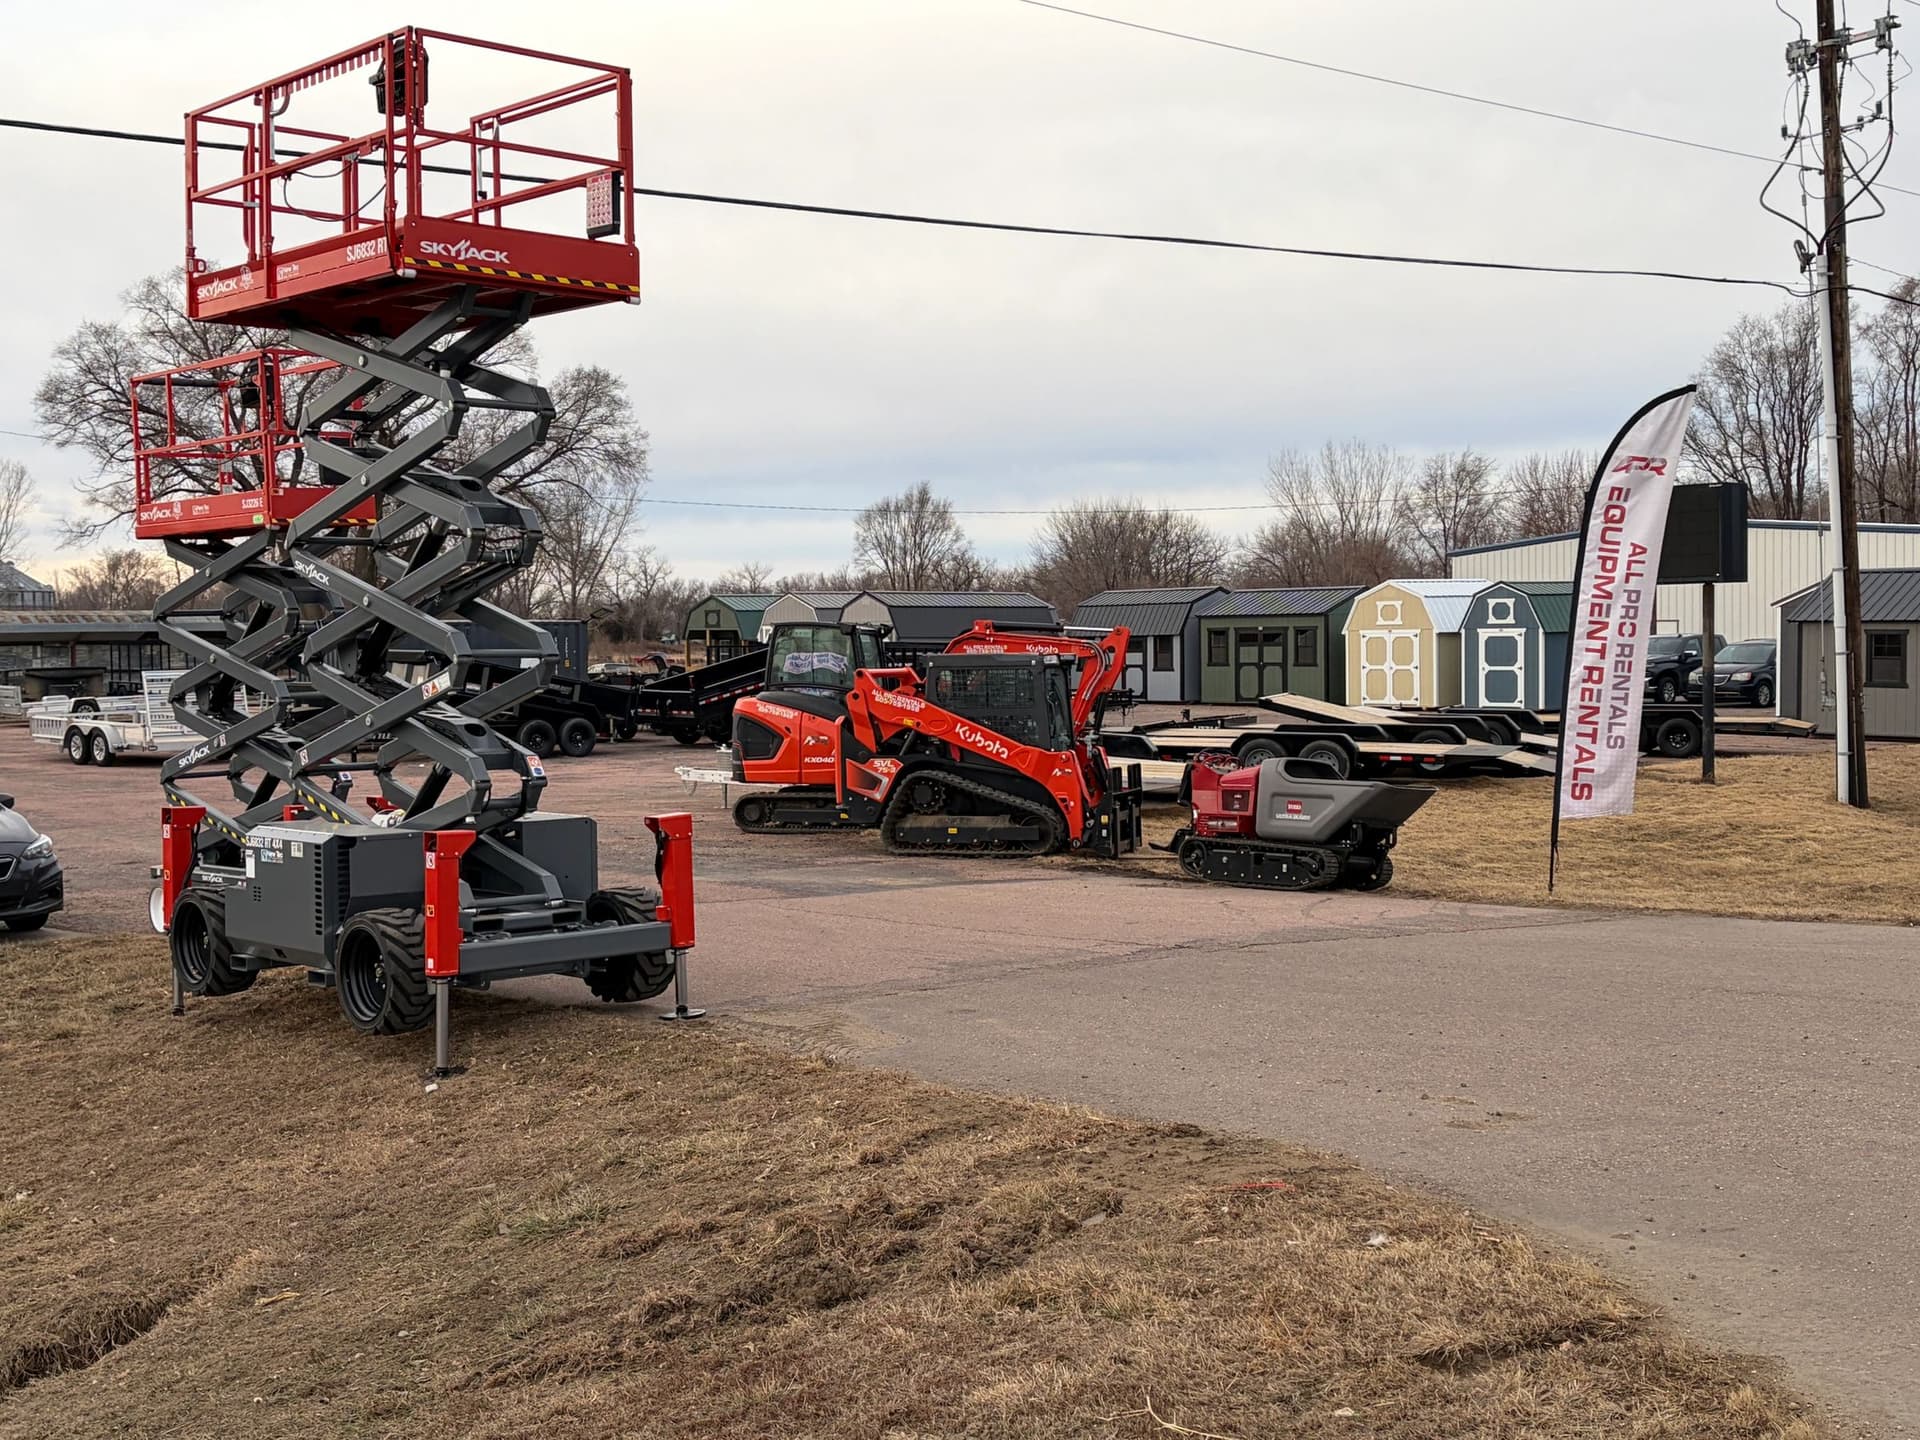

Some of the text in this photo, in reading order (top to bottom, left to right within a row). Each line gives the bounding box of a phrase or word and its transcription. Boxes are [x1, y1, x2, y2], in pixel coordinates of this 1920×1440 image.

[377, 236, 387, 254] RT
[420, 239, 510, 264] SKYJACK
[197, 278, 237, 299] SKYJACK
[140, 506, 171, 521] SKYJACK
[295, 560, 329, 585] SKYJACK
[1026, 643, 1058, 654] Kubota
[1570, 486, 1632, 801] EQUIPMENT RENTALS
[1606, 542, 1648, 750] ALL PRO RENTALS
[955, 722, 1009, 759] Kubota
[178, 745, 210, 768] SKYJACK
